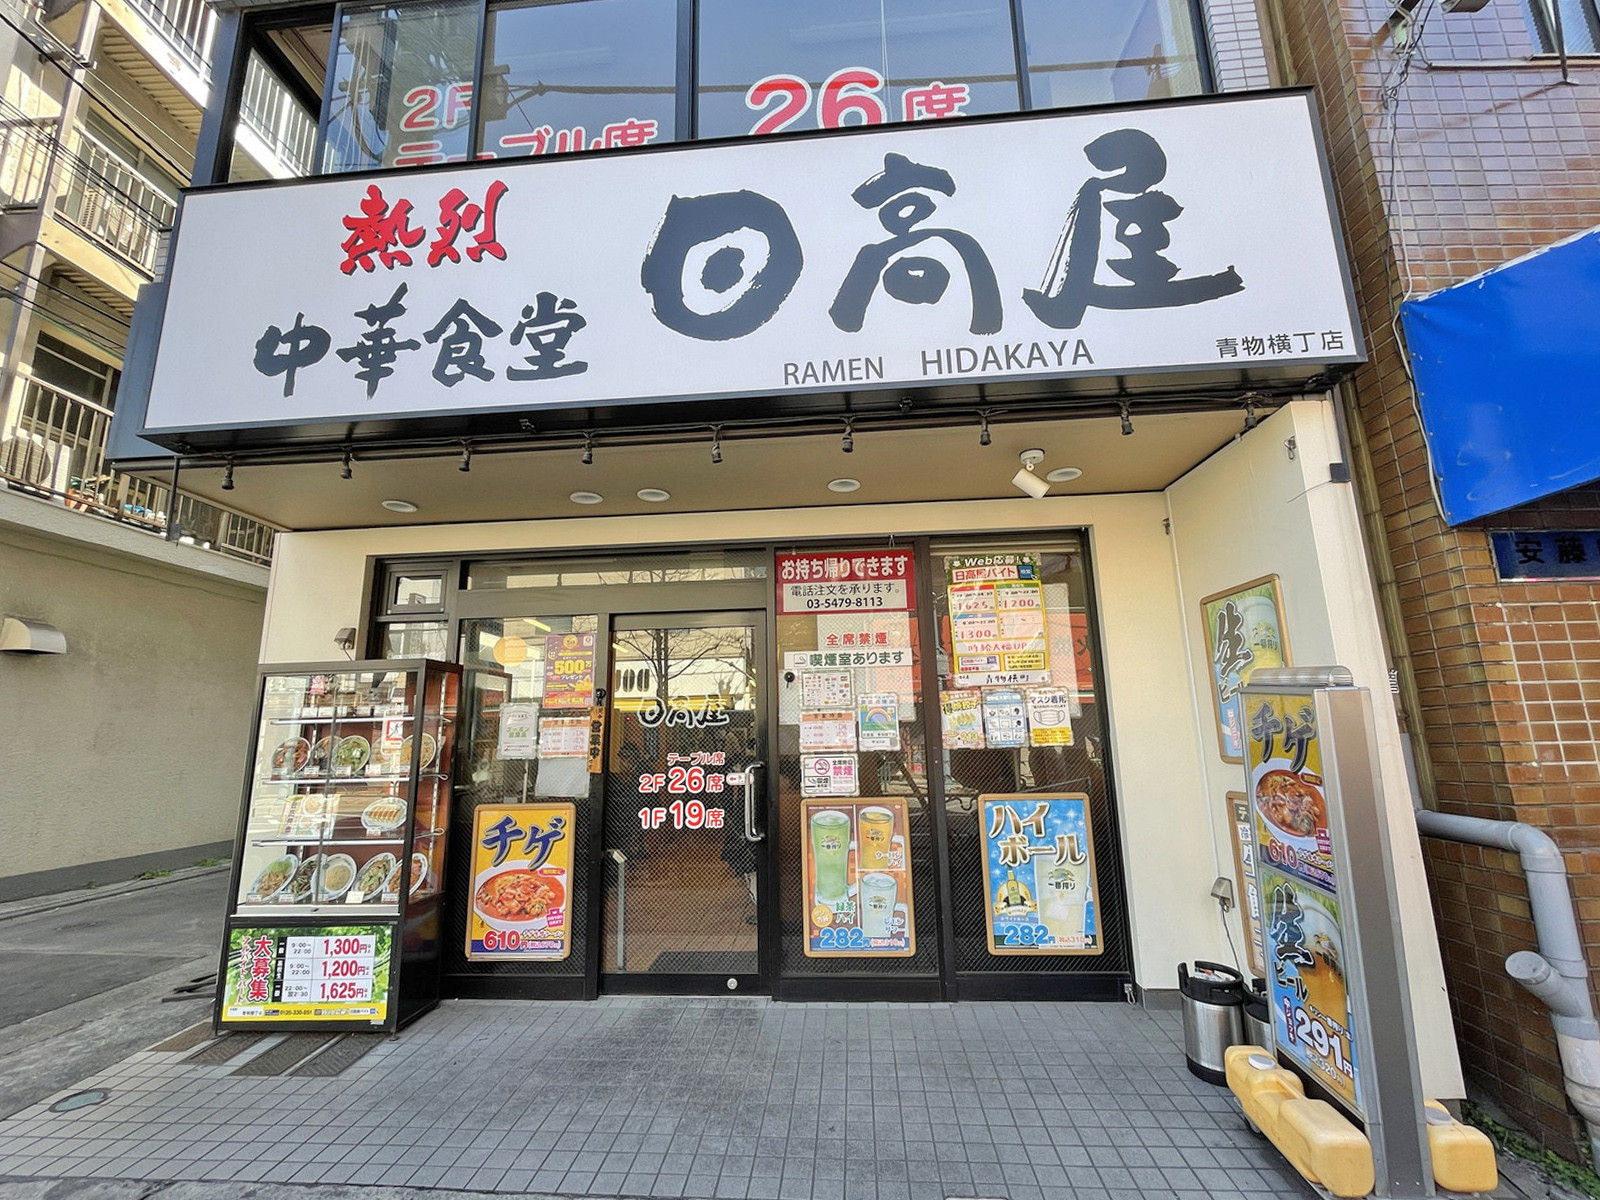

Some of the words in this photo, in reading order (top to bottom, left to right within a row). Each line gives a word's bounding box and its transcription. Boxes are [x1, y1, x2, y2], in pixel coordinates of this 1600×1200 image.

[403, 86, 473, 130] 2F
[340, 180, 508, 276] 熱烈
[641, 128, 1246, 341] 日高屋
[254, 282, 588, 398] 中華食堂
[1216, 330, 1344, 358] 青物横丁店
[783, 356, 884, 386] RAMEN
[920, 339, 1095, 377] HIDAKAYA
[1515, 536, 1600, 565] 安藤
[781, 555, 909, 580] お持ち帰りできます
[790, 582, 900, 598] 電話注文を承ります。
[806, 597, 883, 609] 03-5479-8113
[826, 632, 888, 647] 全席禁煙
[1215, 601, 1254, 678] 生
[809, 651, 904, 667] 喫煙室あります
[1251, 701, 1317, 774] チゲ
[667, 752, 725, 766] テーブル席
[639, 774, 664, 793] 2F
[639, 808, 666, 829] 1F
[989, 803, 1051, 838] ハイ
[481, 814, 567, 871] チゲ
[998, 833, 1087, 867] ボール
[323, 938, 368, 958] 1,300円
[249, 936, 273, 1001] 大募集
[321, 960, 366, 980] 1,200円
[1273, 960, 1308, 1003] ビール
[320, 982, 365, 1002] 1,625円
